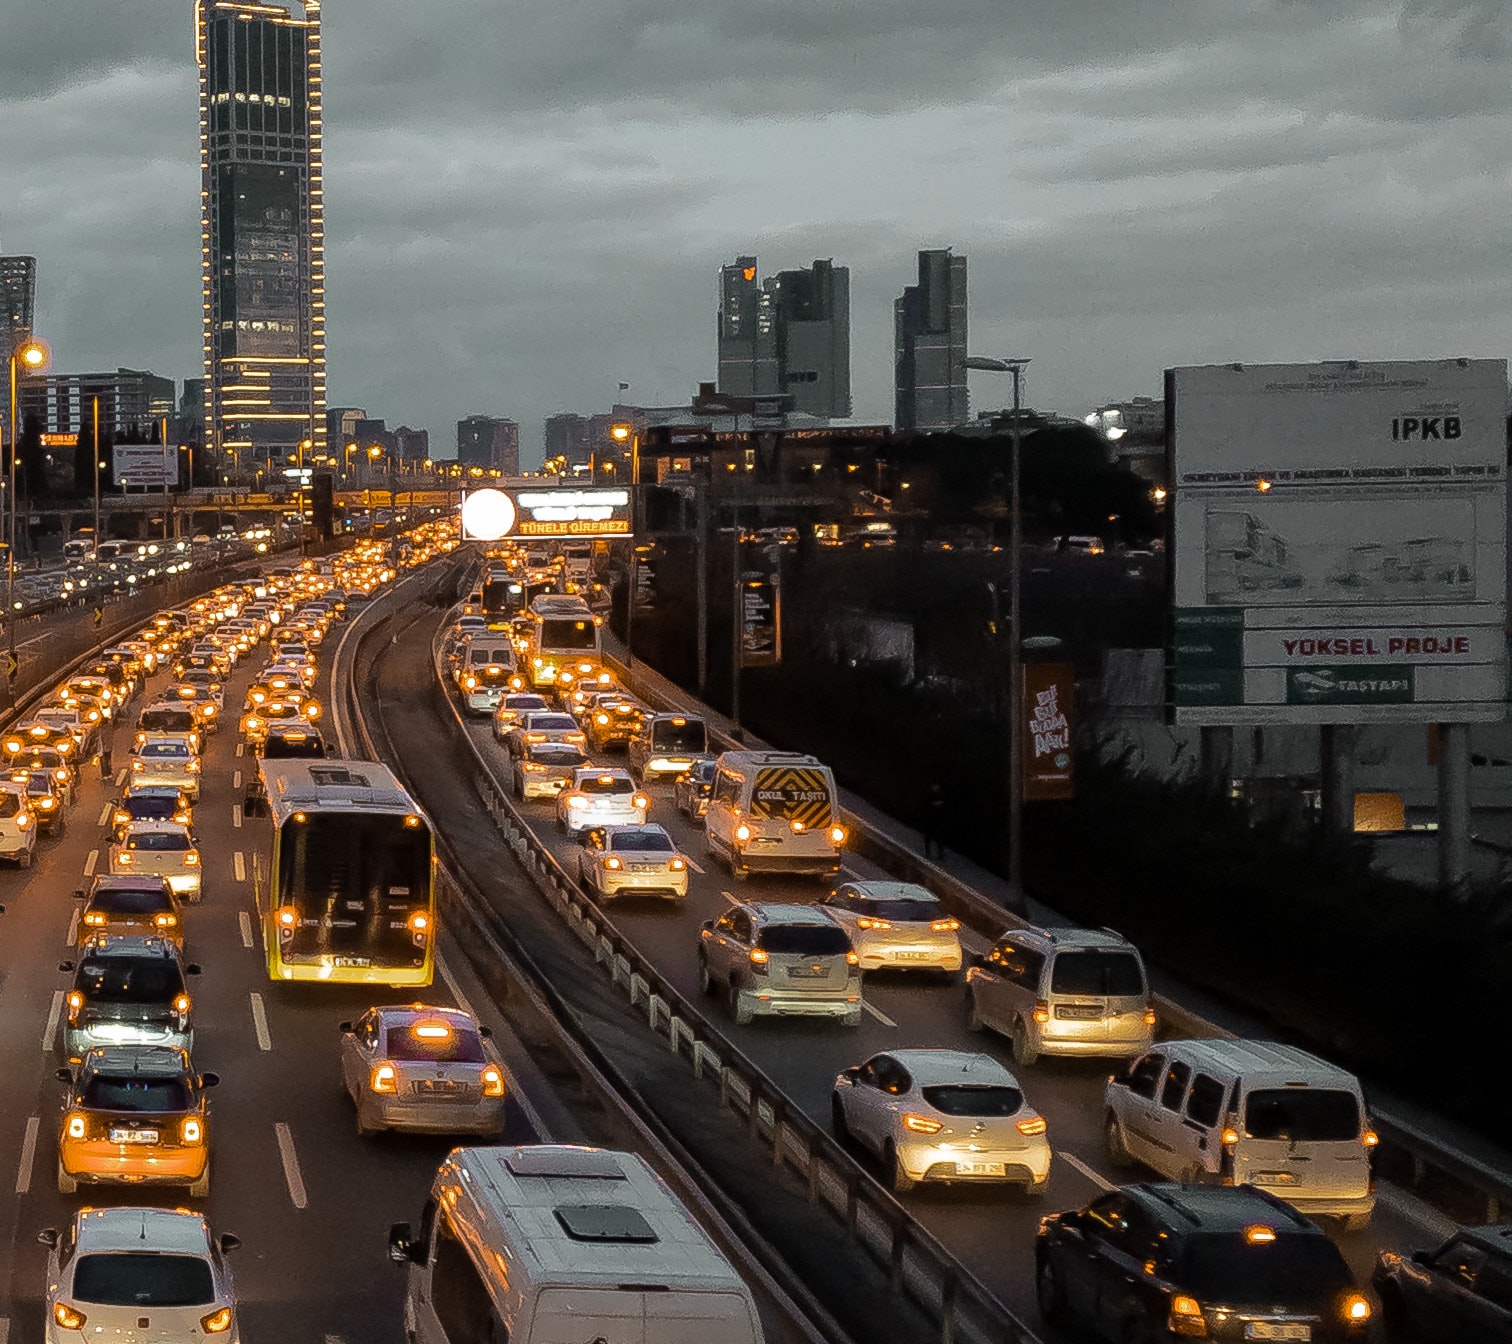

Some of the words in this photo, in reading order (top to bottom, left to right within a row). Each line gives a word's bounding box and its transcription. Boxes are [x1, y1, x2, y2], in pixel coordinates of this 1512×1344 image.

[1391, 416, 1462, 441] IPKB
[521, 520, 568, 533] TÜNELE
[1387, 635, 1471, 655] PROJE
[757, 790, 786, 801] OKUL
[792, 790, 826, 804] TAŞITI
